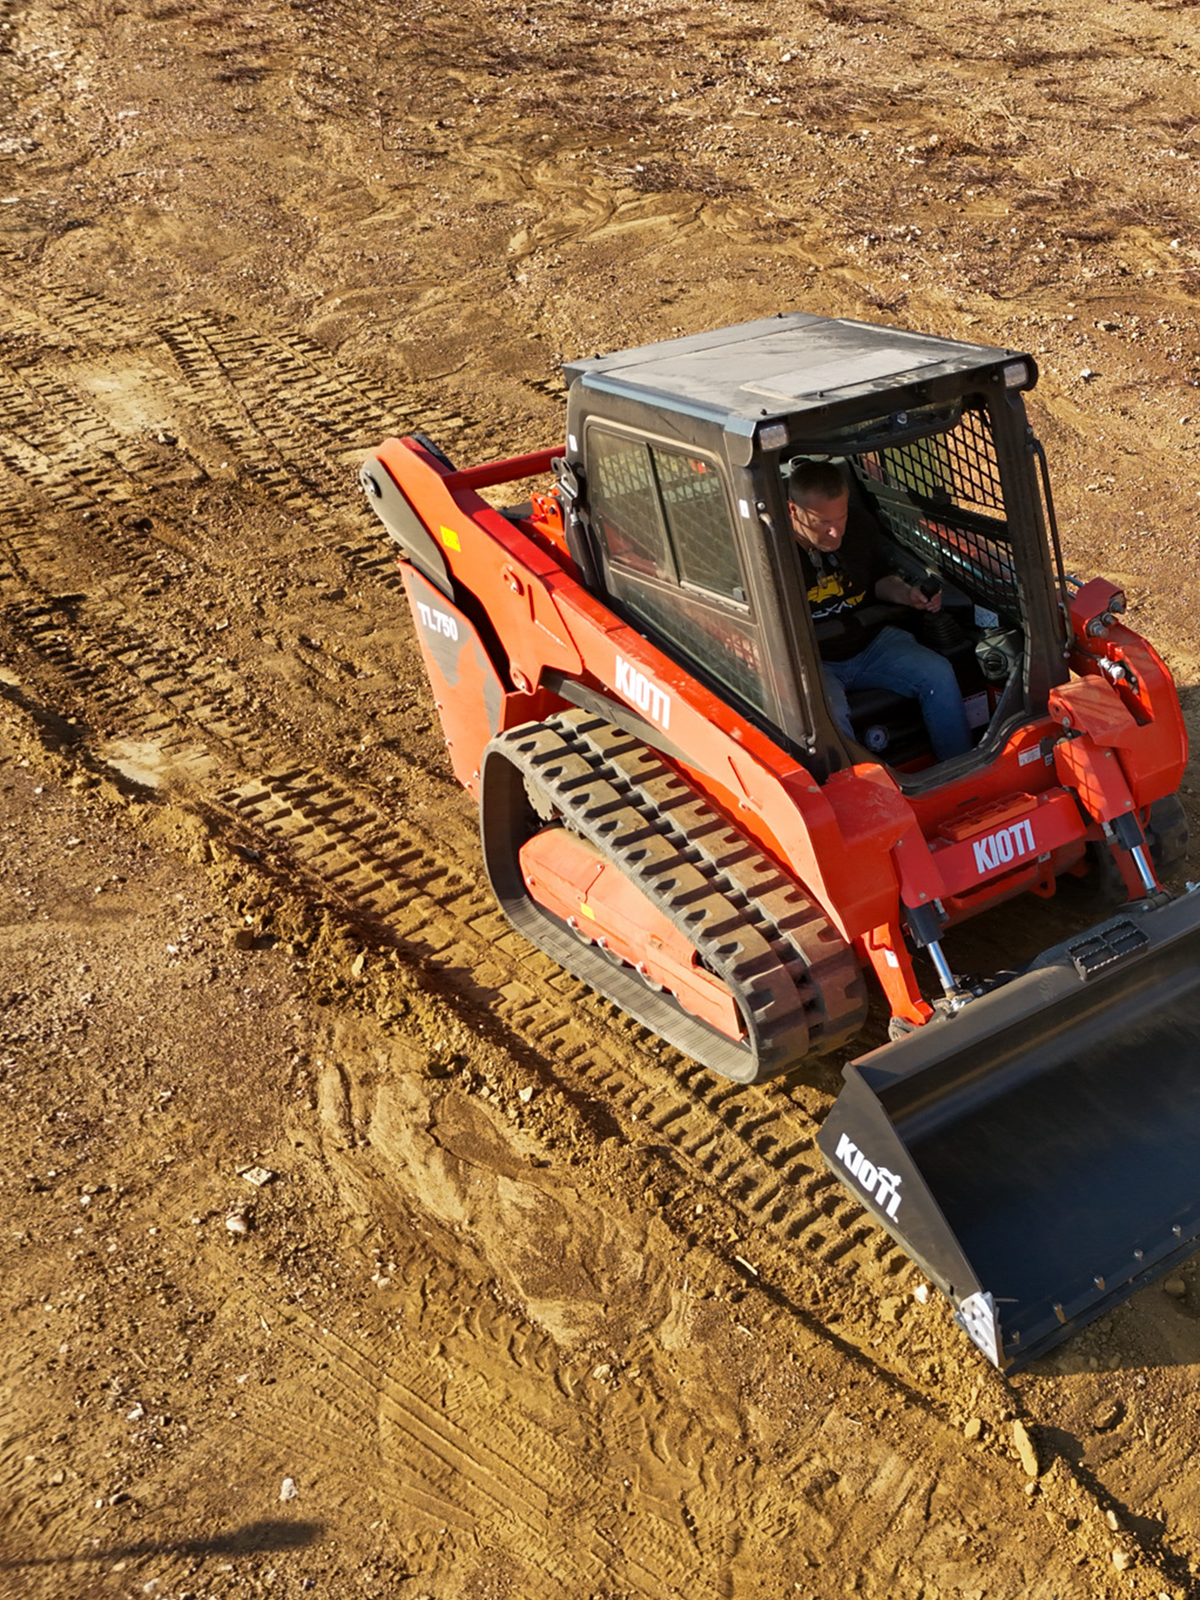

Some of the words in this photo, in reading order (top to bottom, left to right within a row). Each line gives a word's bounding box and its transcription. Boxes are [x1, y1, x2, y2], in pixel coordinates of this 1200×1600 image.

[416, 600, 459, 642] TL750
[615, 654, 671, 731] KIOTI
[972, 818, 1036, 874] KIOTI
[835, 1132, 902, 1219] KIOTI
